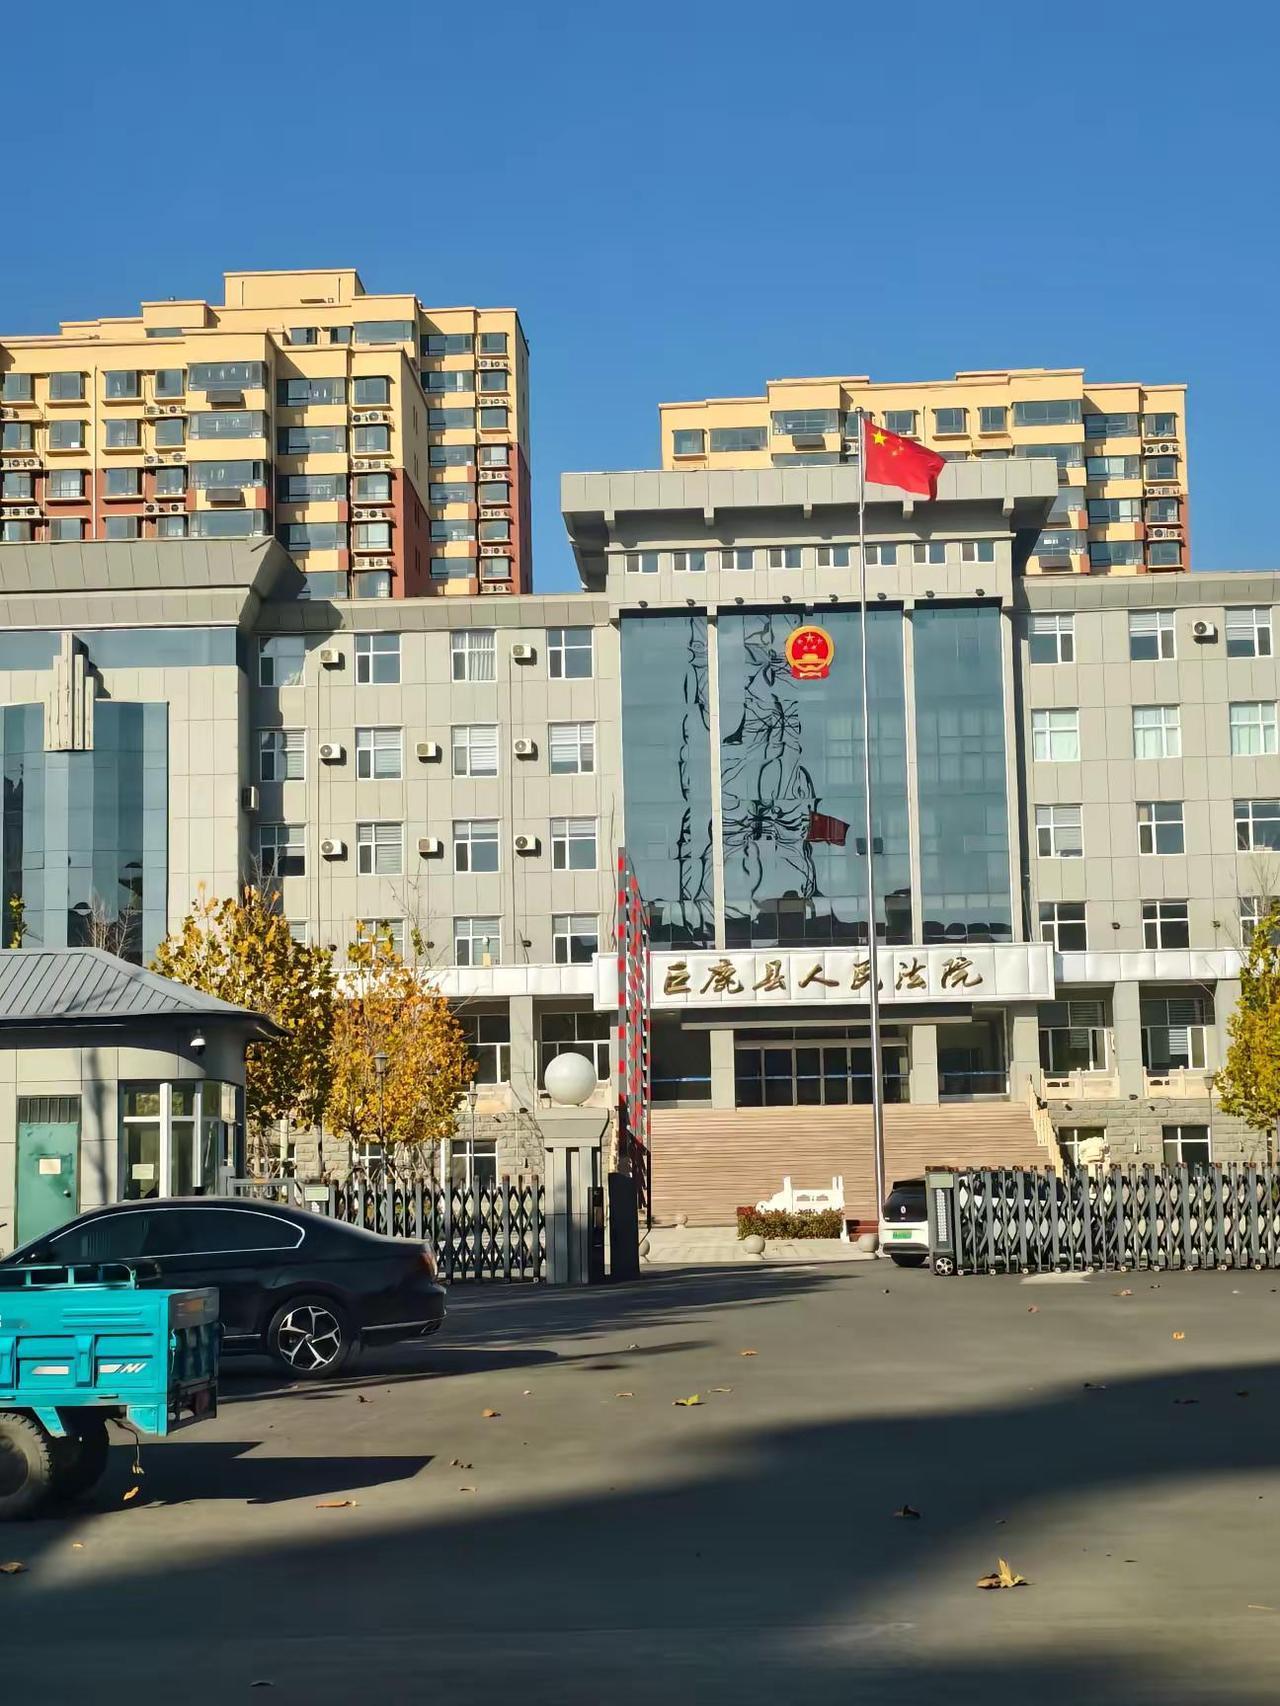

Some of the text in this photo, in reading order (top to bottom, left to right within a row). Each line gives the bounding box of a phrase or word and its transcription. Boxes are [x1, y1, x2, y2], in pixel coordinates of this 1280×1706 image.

[663, 956, 983, 995] 巨鹿县人民法院
